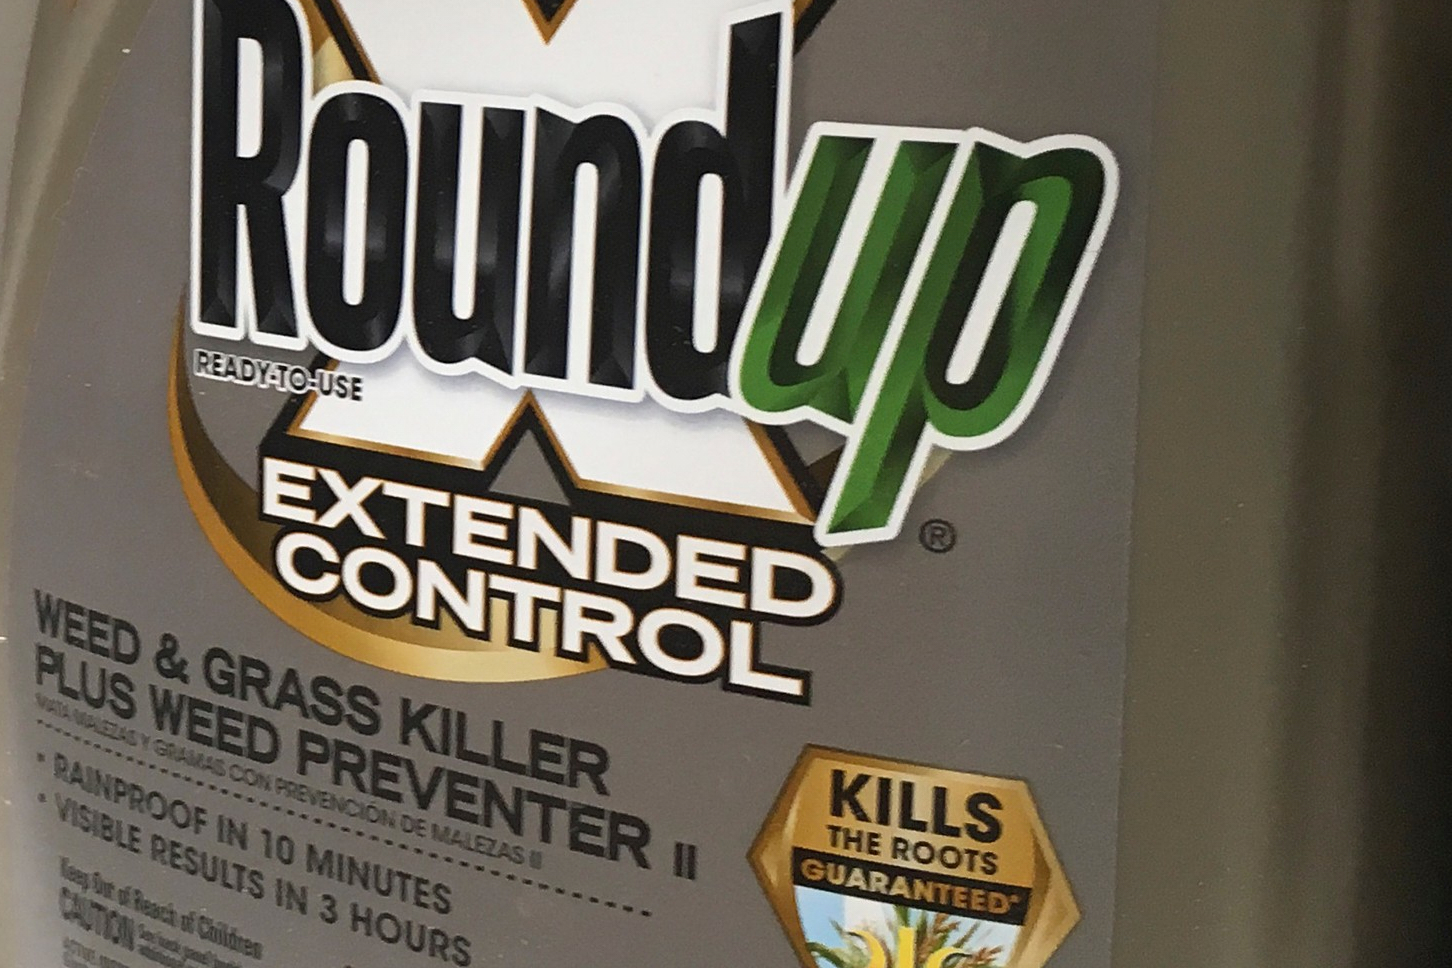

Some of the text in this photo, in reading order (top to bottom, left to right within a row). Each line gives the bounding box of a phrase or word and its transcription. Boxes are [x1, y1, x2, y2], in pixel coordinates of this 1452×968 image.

[196, 350, 363, 402] READY-TO-USE
[262, 456, 838, 619] EXTENDED
[274, 530, 804, 697] CONTROL
[34, 589, 611, 796] WEED & GRASS KILLER
[35, 642, 697, 881] PLUS WEED PREVENTER II
[53, 752, 453, 916] RAINPROOF IN 10 MINUTES
[53, 791, 472, 968] VISIBLE RESULTS IN 3 HOURS
[228, 763, 271, 792] CON
[275, 777, 396, 829] PREVENCIÓN
[401, 813, 427, 838] DE
[432, 823, 526, 865] MALEZAS
[826, 824, 1000, 877] THE ROOTS
[829, 768, 1005, 844] KILLS
